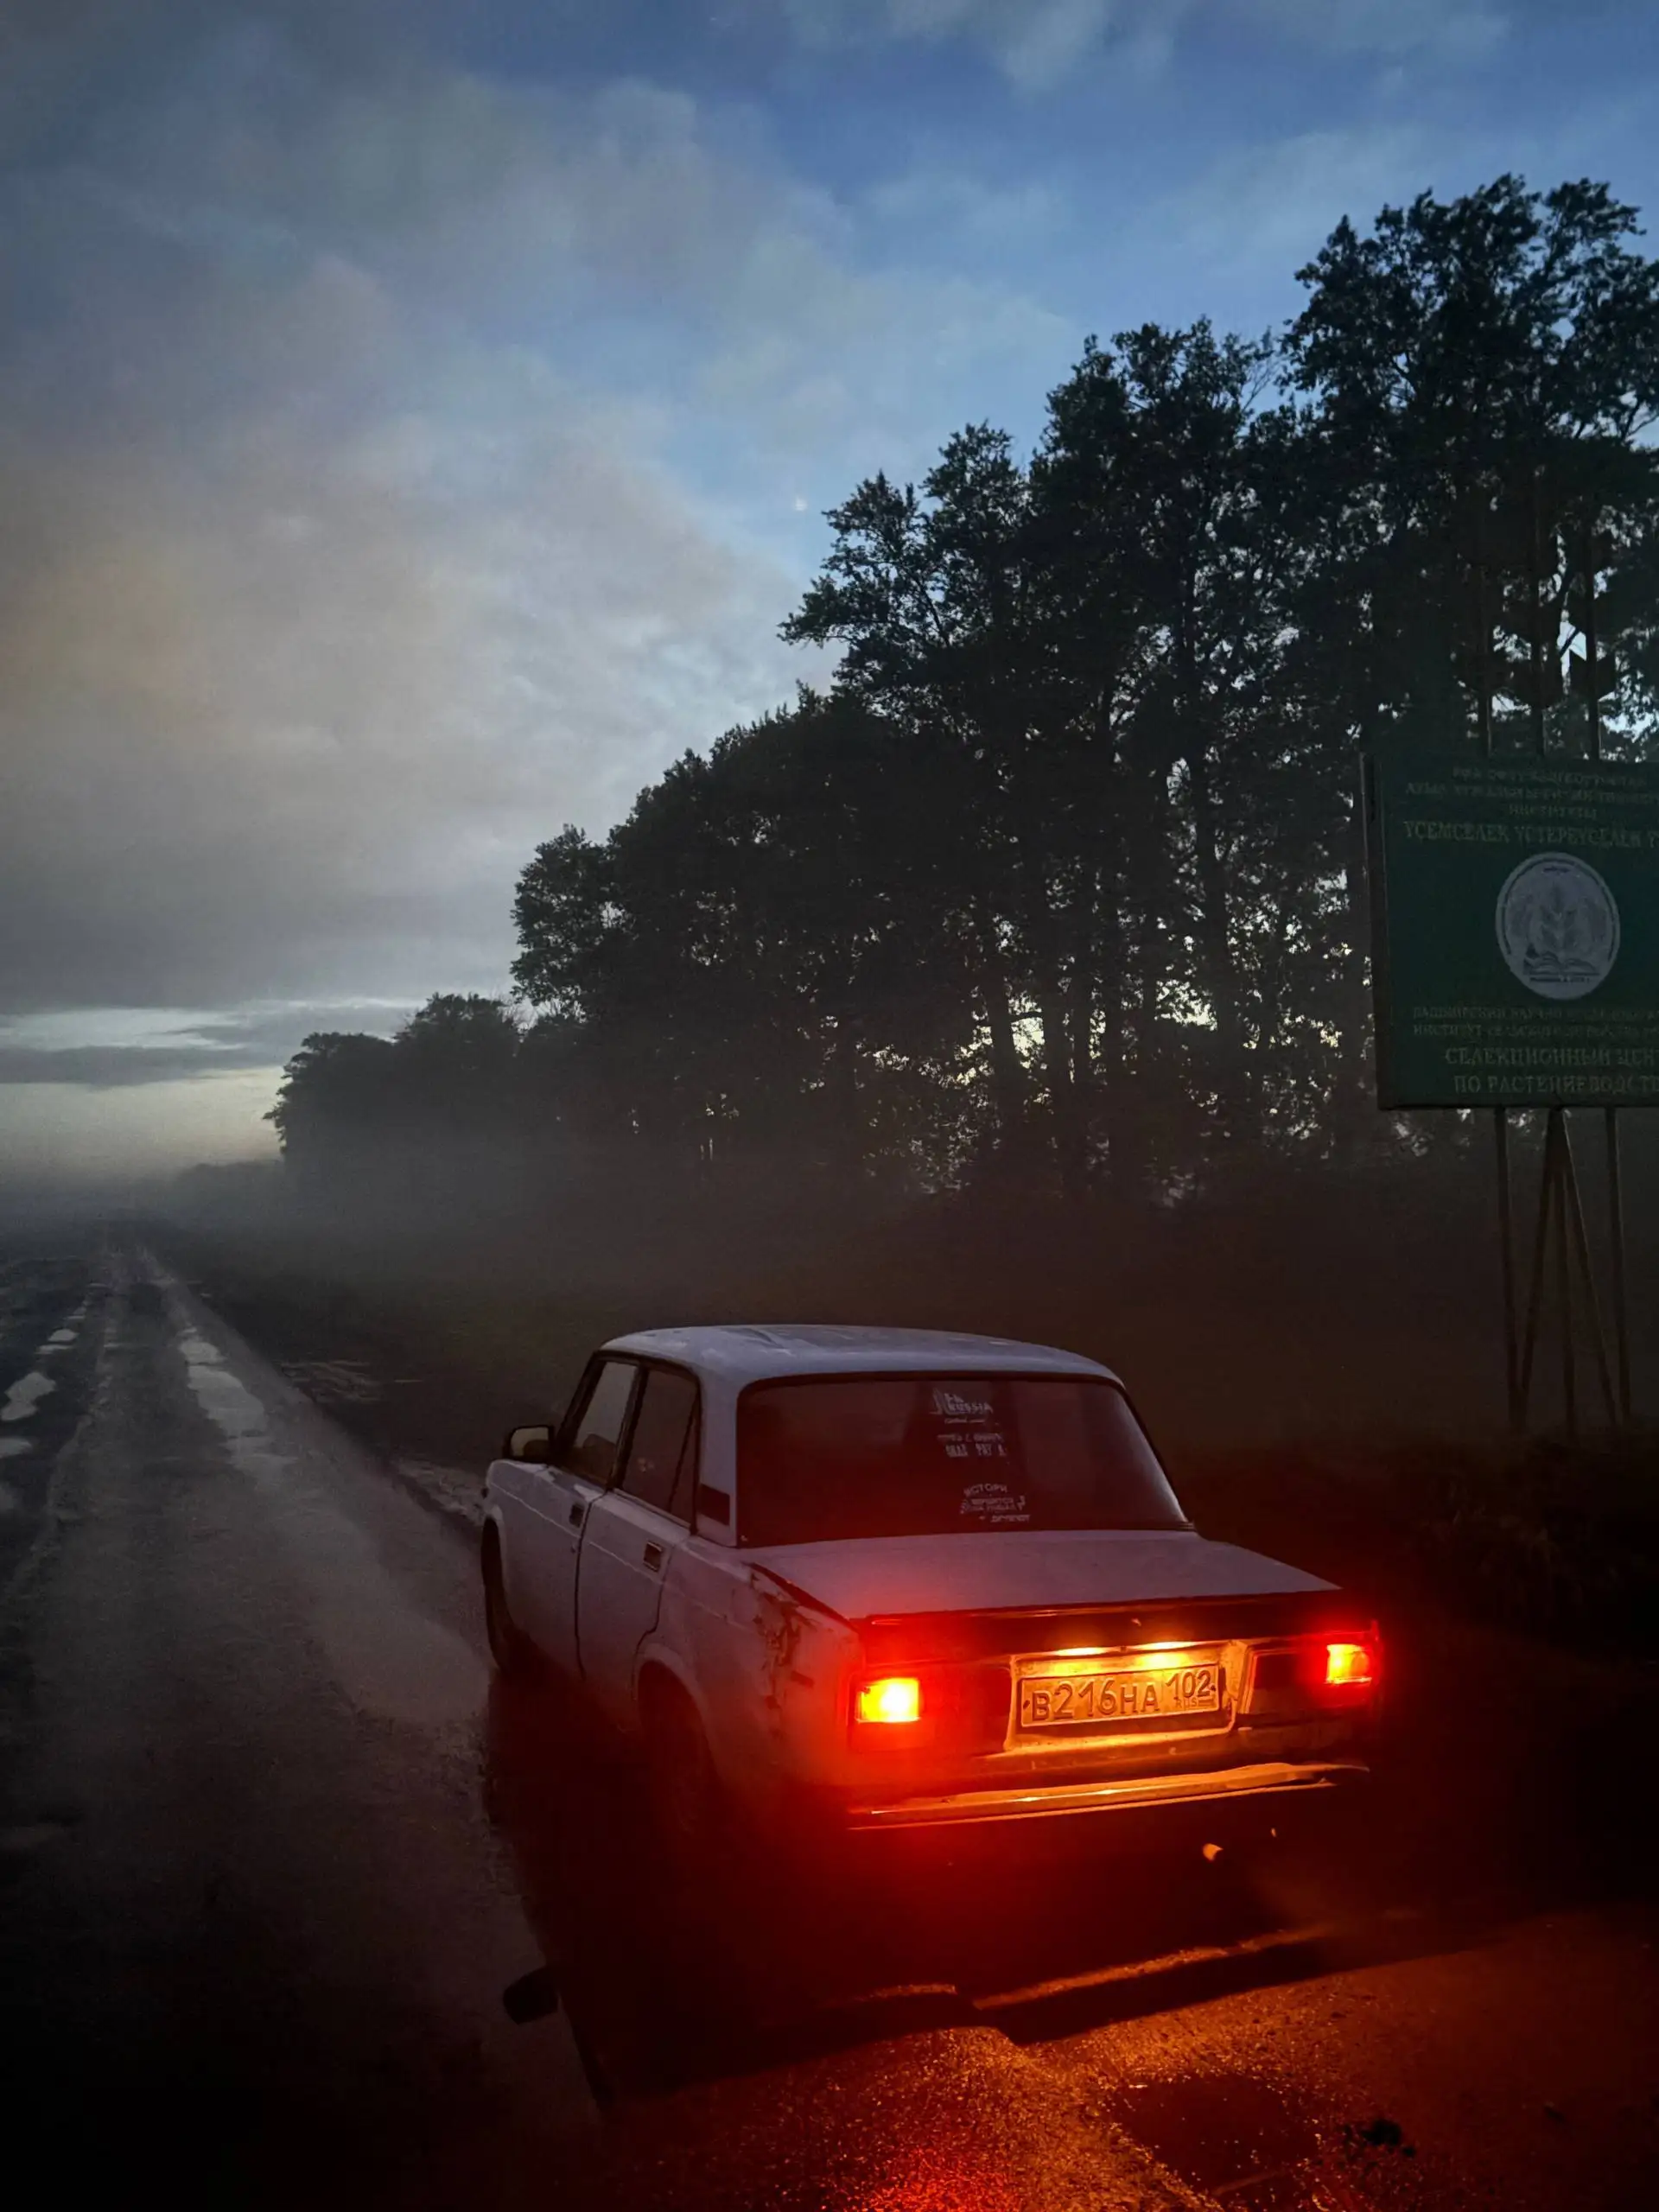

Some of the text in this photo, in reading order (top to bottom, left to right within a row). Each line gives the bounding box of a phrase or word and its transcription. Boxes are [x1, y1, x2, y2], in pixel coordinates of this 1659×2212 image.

[1444, 1045, 1659, 1067] СЕЛЕКЦИОННЫЙ ЦЕН
[1453, 1074, 1481, 1094] ПО
[1165, 1669, 1211, 1700] 102
[1174, 1696, 1198, 1709] RUS
